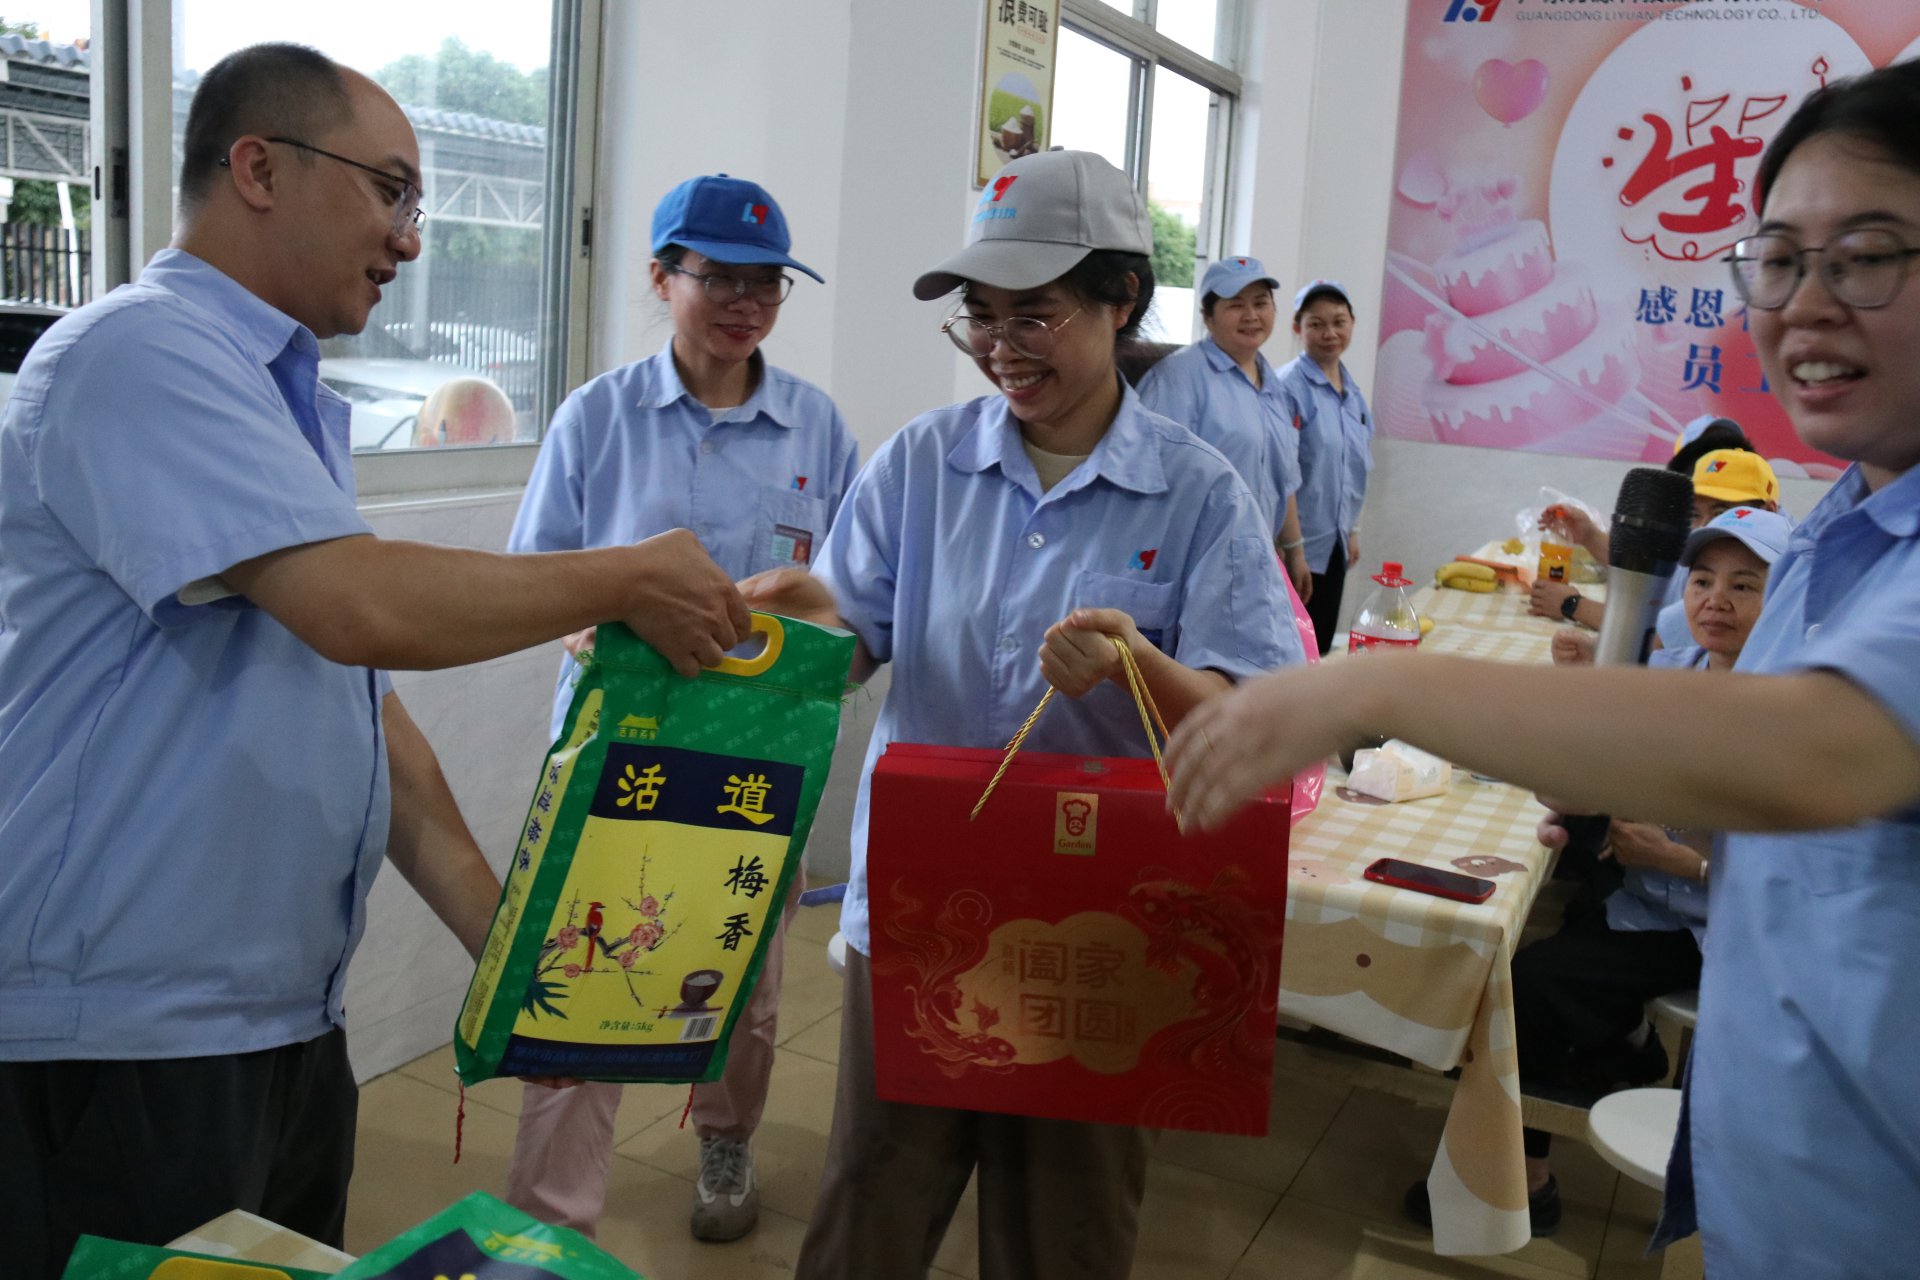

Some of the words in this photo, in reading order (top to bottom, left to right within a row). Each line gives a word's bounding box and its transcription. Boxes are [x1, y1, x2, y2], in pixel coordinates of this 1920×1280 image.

[1516, 11, 1601, 21] GUANGDONG
[1605, 10, 1653, 21] LIYUAN
[1658, 9, 1756, 20] TECHNOLOGY
[1619, 113, 1764, 233] 生
[616, 764, 775, 825] 活道
[1058, 839, 1092, 849] Garden
[715, 855, 769, 951] 梅香
[1020, 993, 1122, 1042] 团圆
